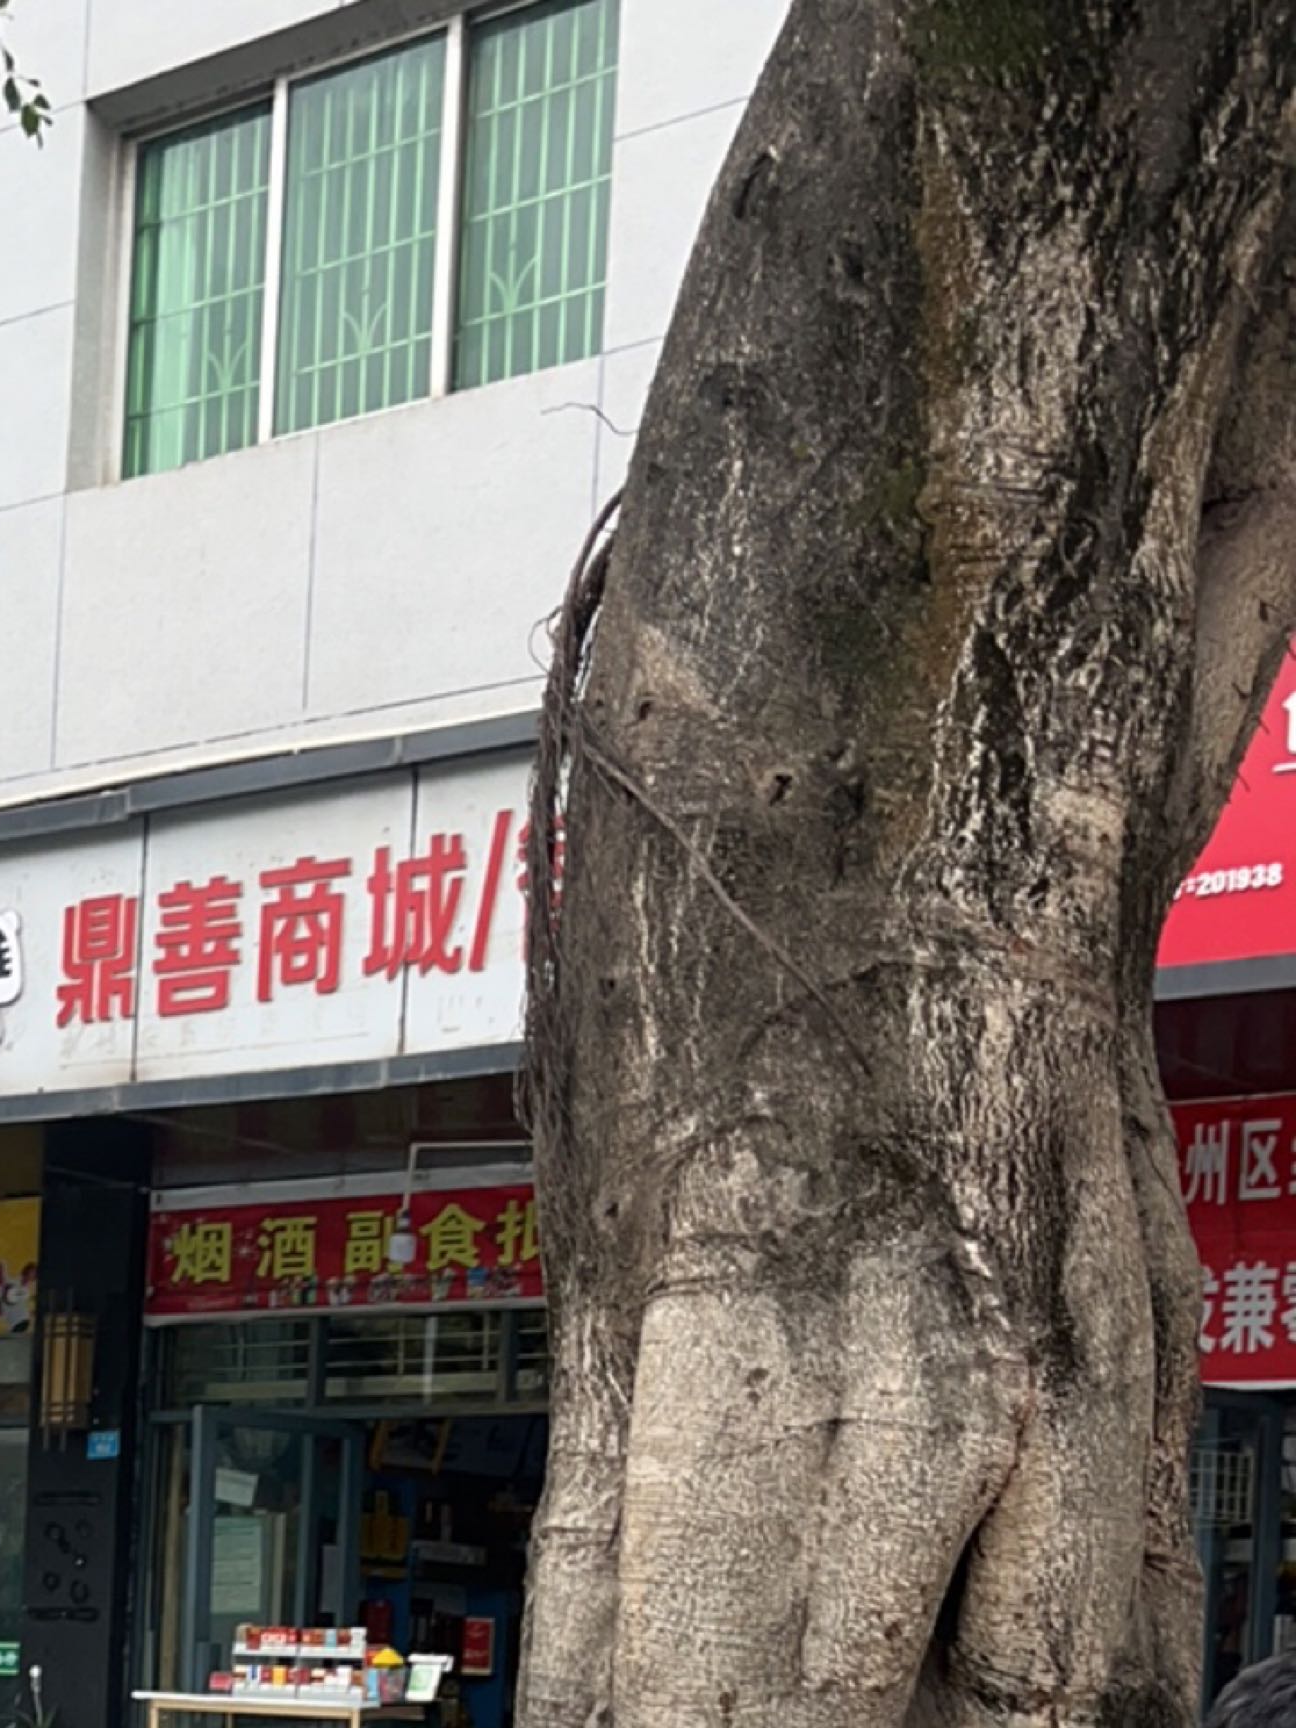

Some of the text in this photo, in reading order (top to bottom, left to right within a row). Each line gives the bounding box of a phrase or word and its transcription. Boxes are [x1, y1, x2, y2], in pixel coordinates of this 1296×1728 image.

[56, 809, 566, 1028] 鼎善商城/
[1185, 1119, 1296, 1206] 州区
